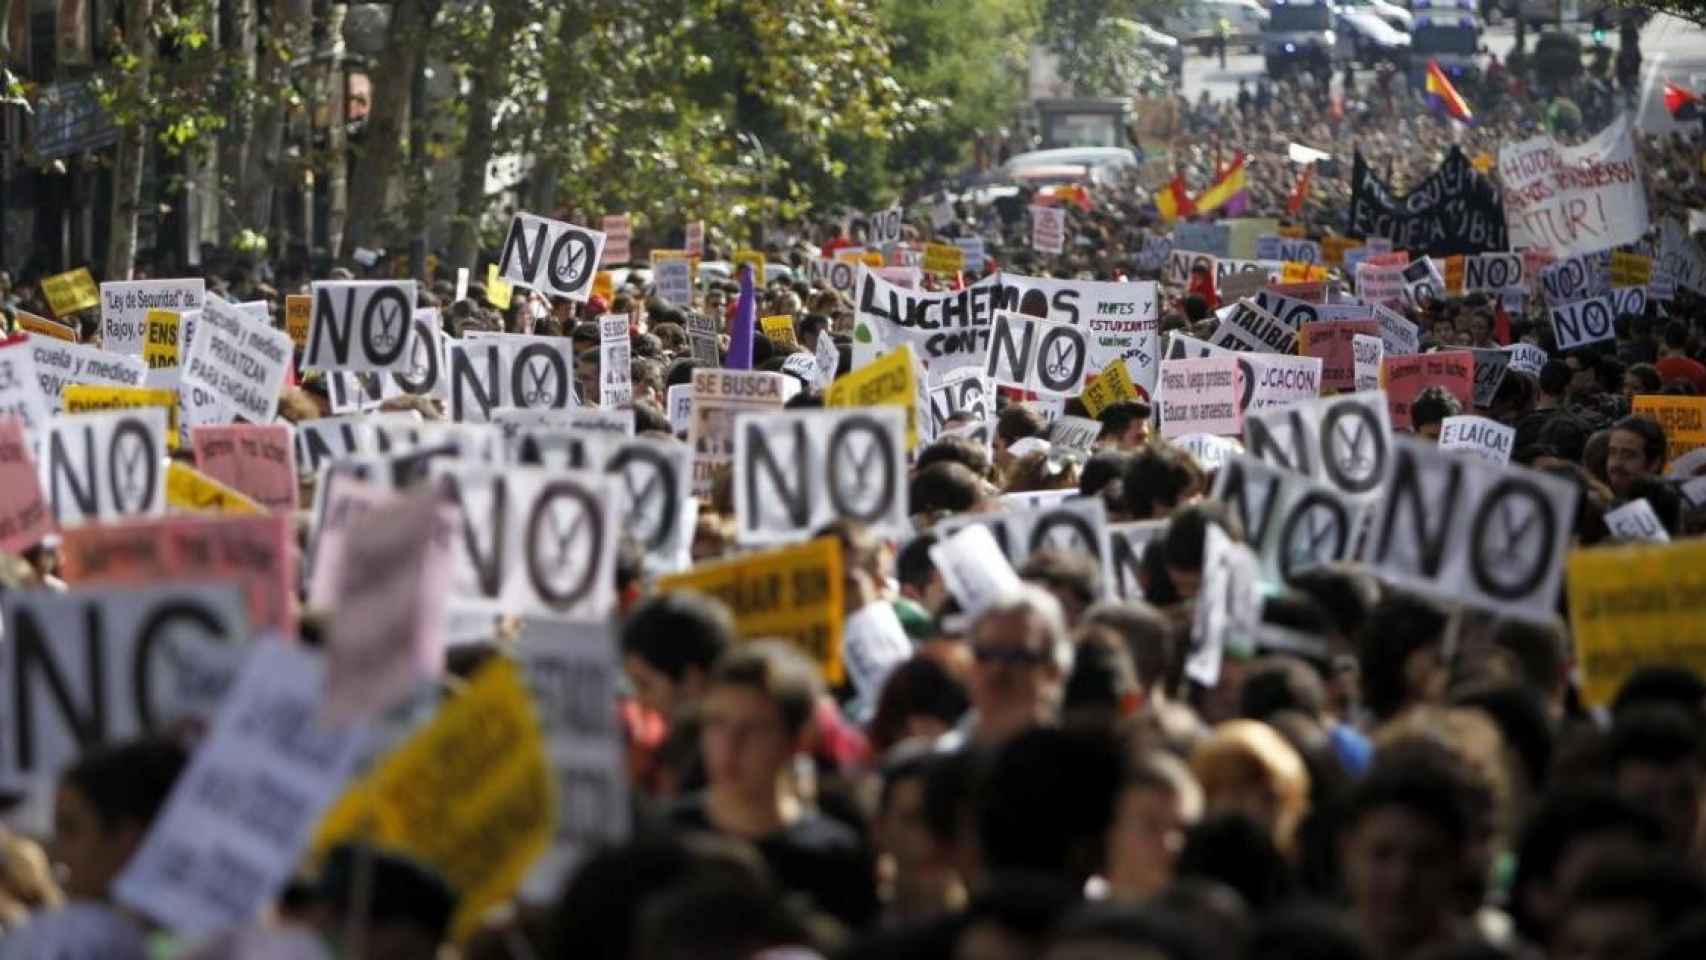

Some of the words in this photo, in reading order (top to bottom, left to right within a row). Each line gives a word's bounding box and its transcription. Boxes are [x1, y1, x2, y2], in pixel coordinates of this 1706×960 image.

[502, 216, 596, 292] NO
[872, 210, 898, 240] NO
[860, 272, 1081, 330] LUCHEMOS
[1143, 301, 1152, 314] Y
[1467, 257, 1508, 288] NO
[308, 286, 411, 366] NO
[987, 315, 1086, 392] NO
[1553, 300, 1610, 346] NO
[74, 356, 85, 375] y
[86, 359, 139, 385] medios
[452, 343, 568, 421] NO
[696, 374, 717, 392] SE
[720, 374, 778, 397] BUSCA
[50, 417, 158, 520] NO
[748, 415, 895, 530] NO
[1248, 402, 1387, 492] NO
[446, 473, 606, 612] NO
[1377, 453, 1558, 600] NO
